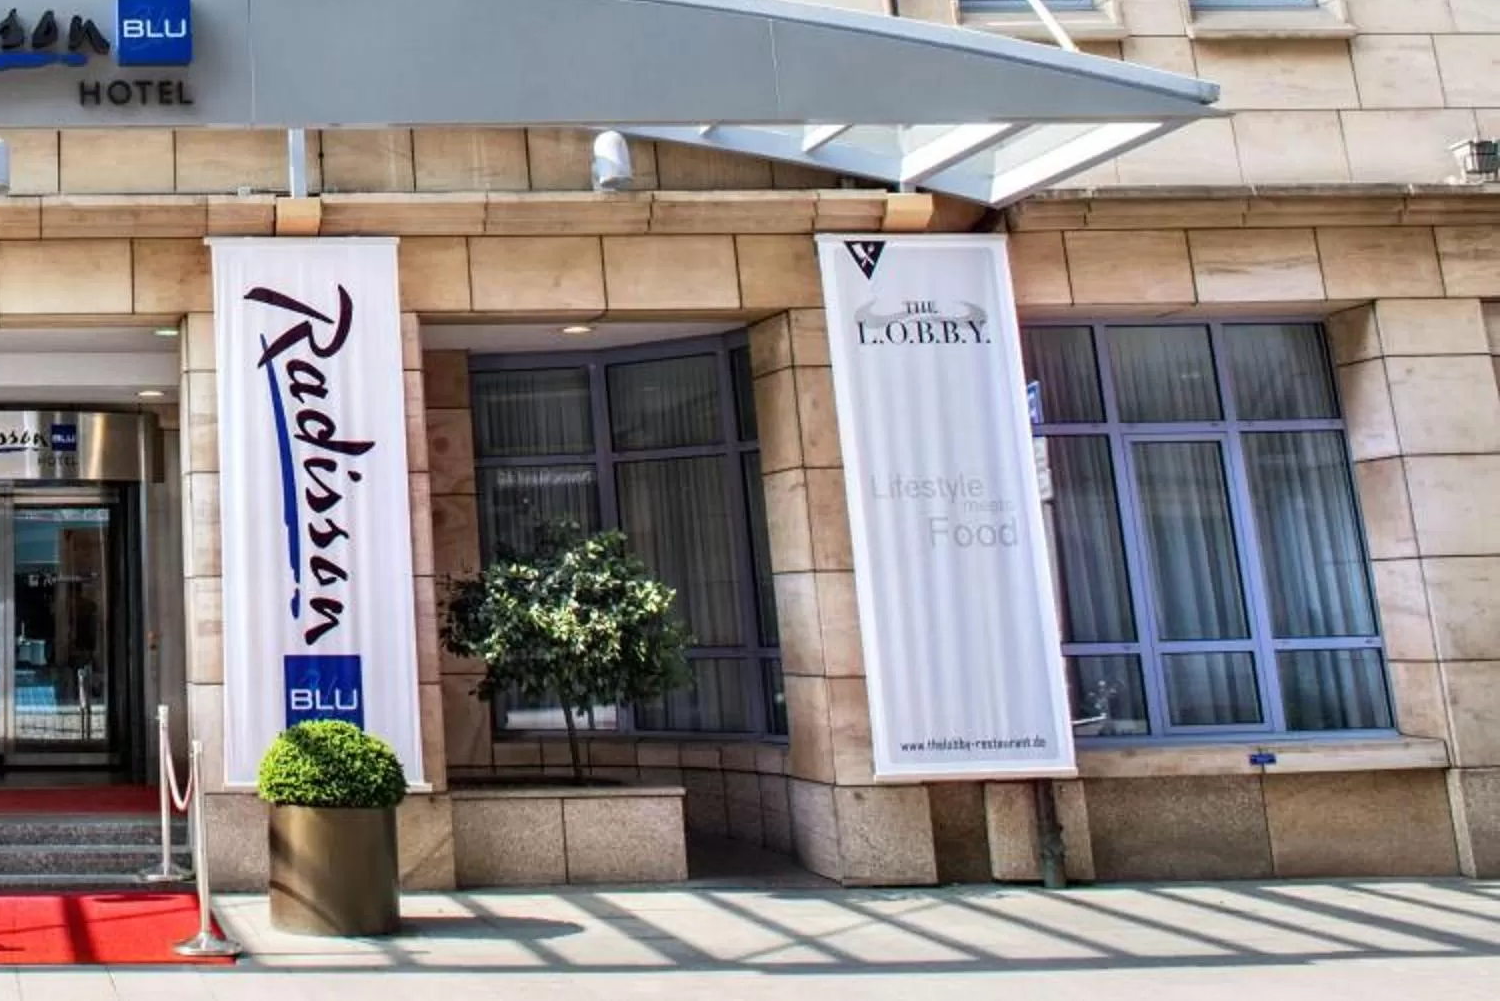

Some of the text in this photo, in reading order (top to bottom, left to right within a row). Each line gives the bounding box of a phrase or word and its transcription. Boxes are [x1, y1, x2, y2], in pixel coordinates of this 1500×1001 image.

[123, 19, 188, 38] BLU
[79, 80, 195, 106] HOTEL
[903, 301, 938, 314] THE
[244, 284, 375, 646] Radisson
[871, 472, 984, 503] Lifestyle
[931, 517, 1018, 547] Food
[290, 689, 358, 710] BLU
